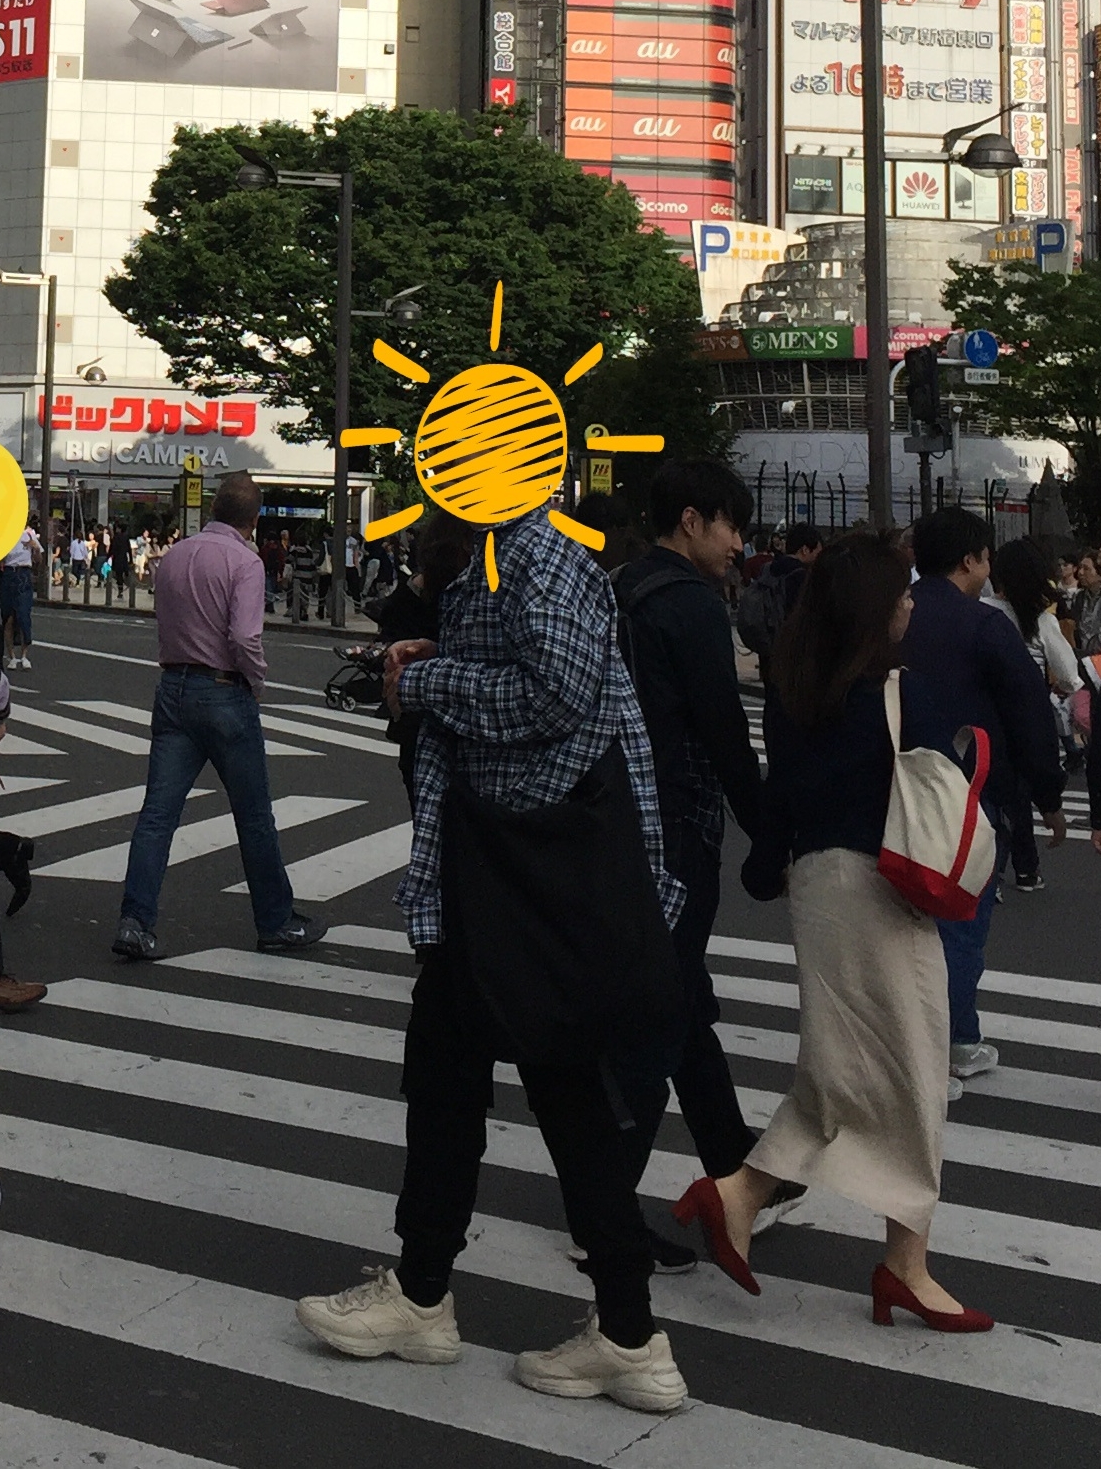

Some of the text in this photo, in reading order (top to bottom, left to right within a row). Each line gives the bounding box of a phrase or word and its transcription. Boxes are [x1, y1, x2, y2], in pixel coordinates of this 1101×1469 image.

[494, 12, 514, 72] 総合館
[570, 38, 608, 55] au
[636, 41, 681, 60] au
[570, 116, 606, 132] au
[633, 117, 681, 137] au
[1013, 115, 1029, 156] テレビ
[1065, 148, 1080, 184] TAX
[795, 177, 832, 187] HITACHI
[902, 202, 940, 211] HUAWEI
[700, 224, 730, 272] P
[1037, 223, 1067, 273] P
[38, 394, 257, 437] ビックカメラ
[65, 440, 230, 468] BIC CAMERA
